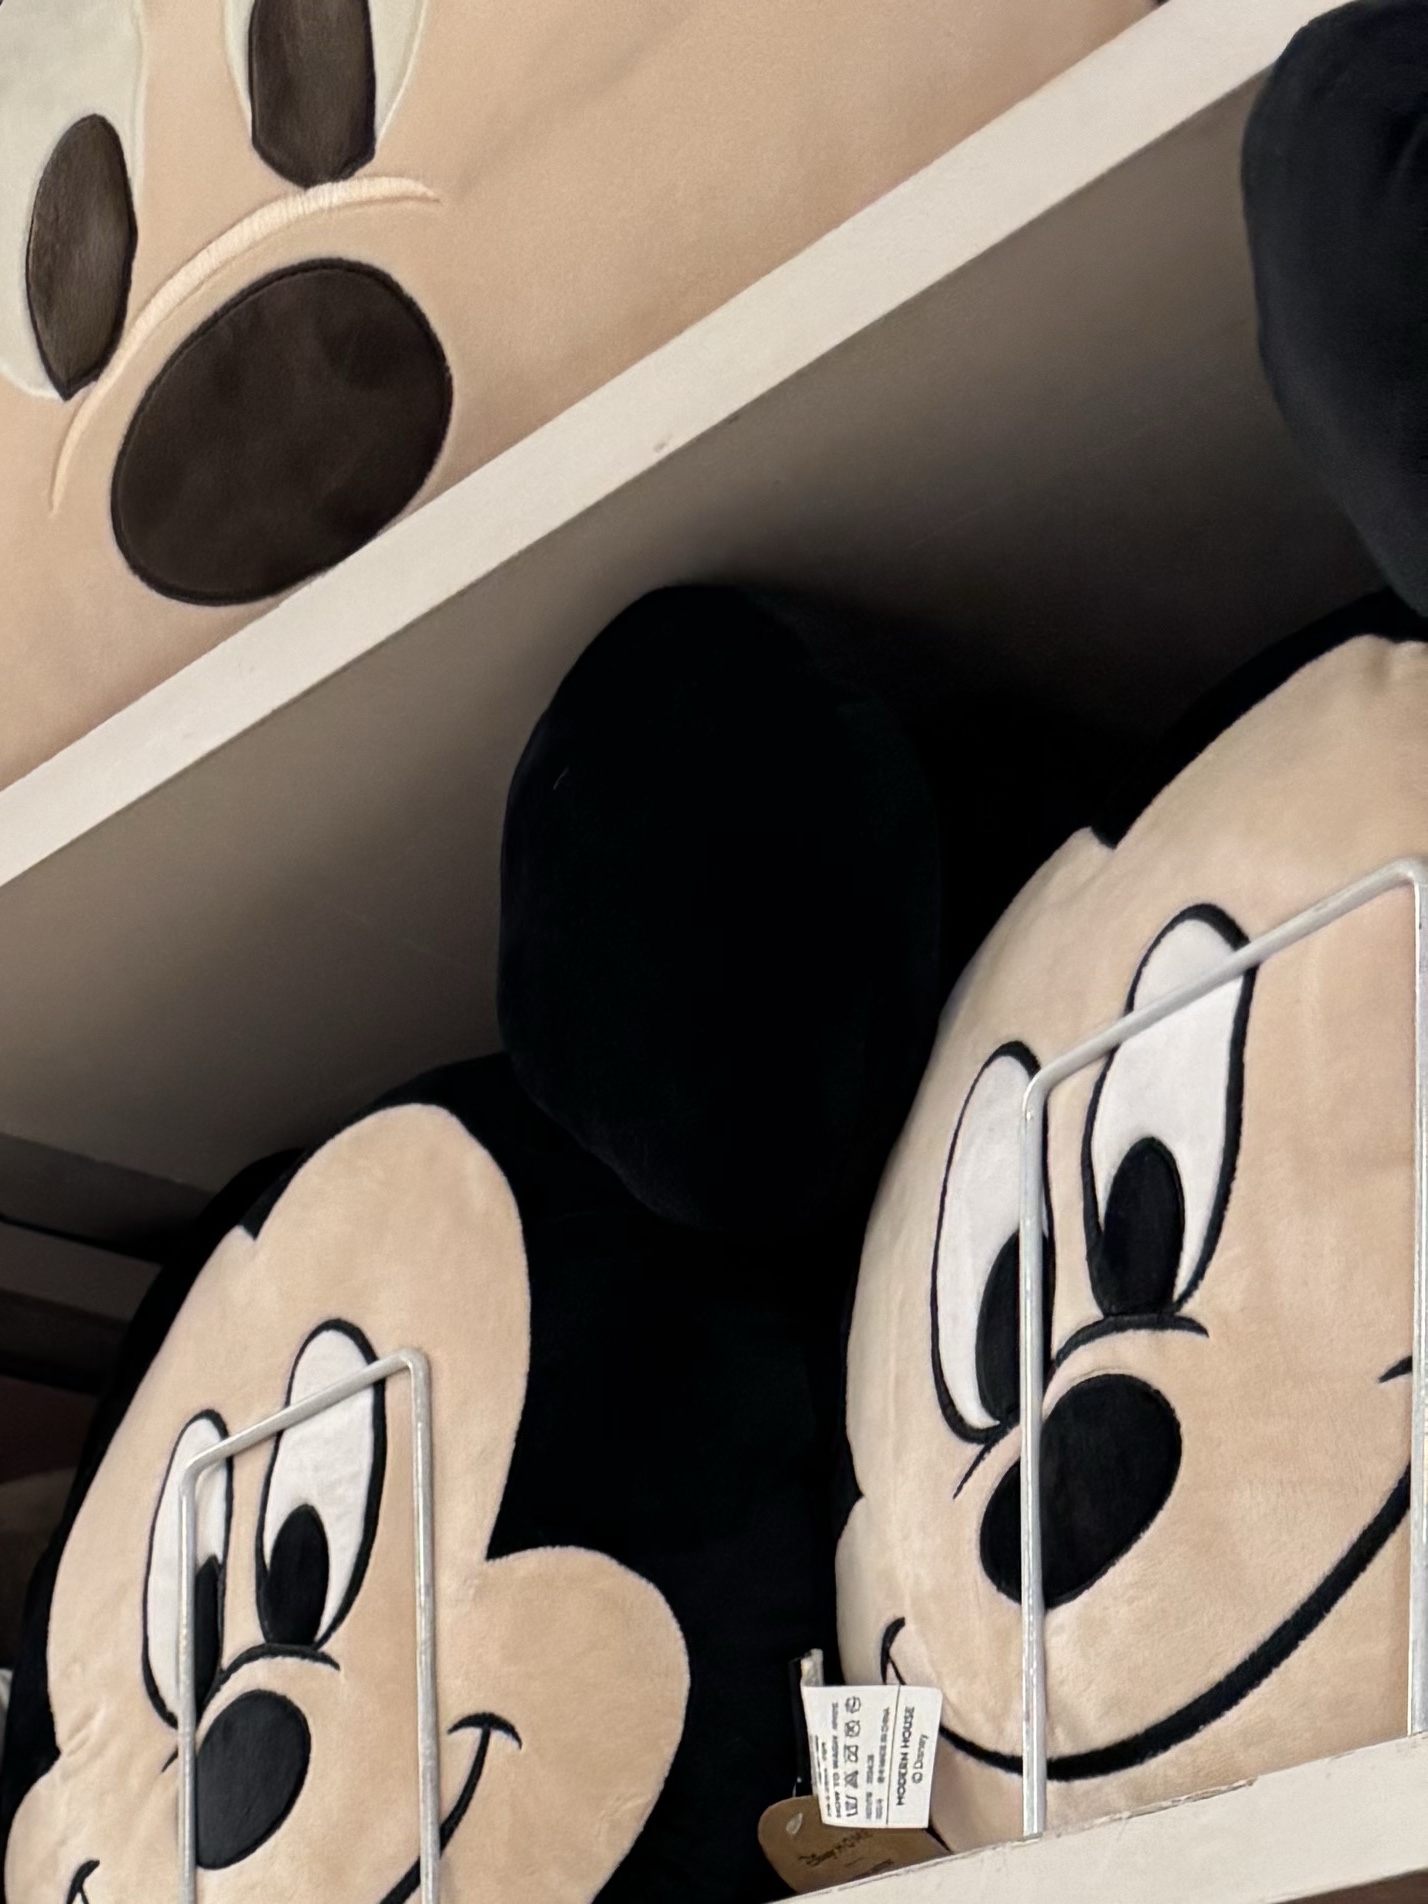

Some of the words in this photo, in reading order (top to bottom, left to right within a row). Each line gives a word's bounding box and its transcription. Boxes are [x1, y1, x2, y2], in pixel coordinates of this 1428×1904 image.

[902, 1706, 915, 1748] HOUSE
[913, 1734, 929, 1770] Disney
[896, 1752, 909, 1806] MODERN
